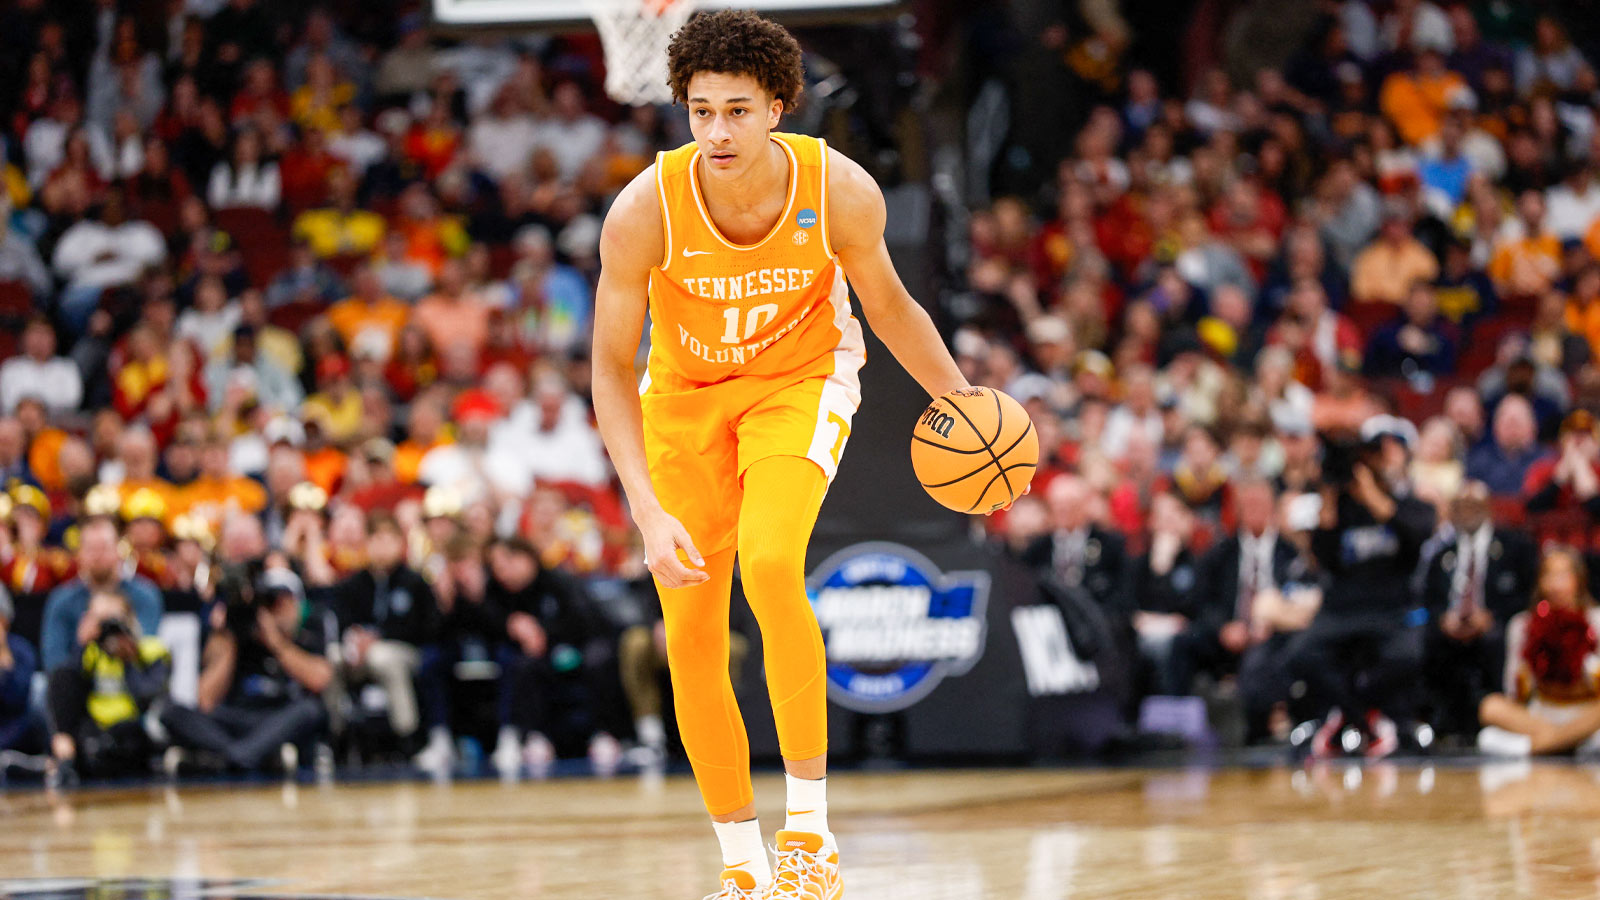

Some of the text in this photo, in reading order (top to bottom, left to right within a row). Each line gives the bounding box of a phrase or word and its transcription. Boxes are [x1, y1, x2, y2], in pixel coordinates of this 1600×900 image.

[793, 230, 808, 245] SEC
[683, 268, 814, 300] TENNESSEE
[720, 303, 779, 344] 10
